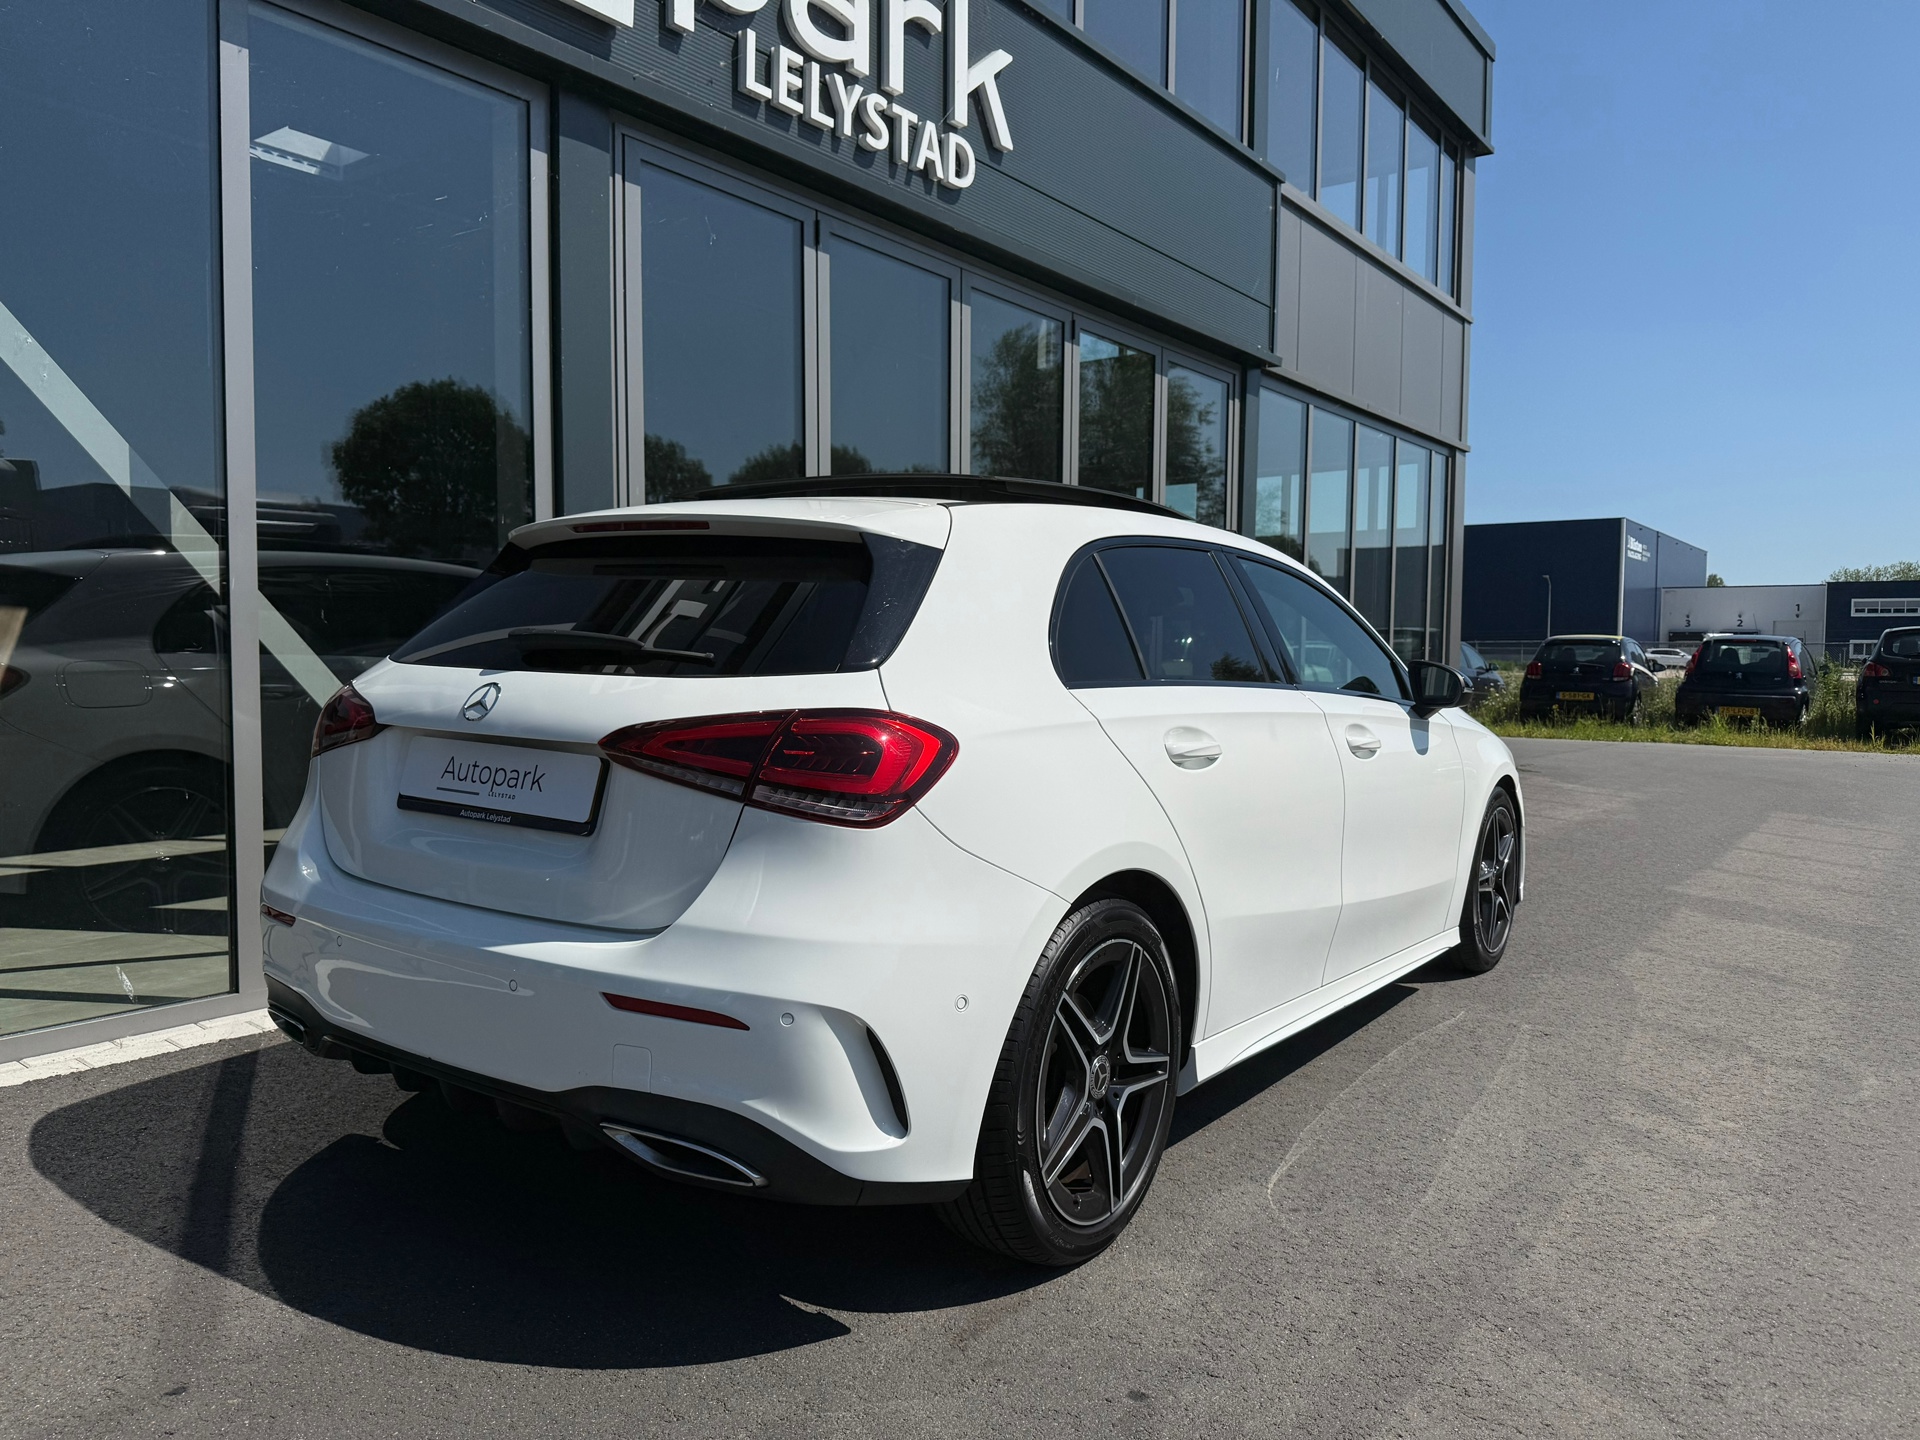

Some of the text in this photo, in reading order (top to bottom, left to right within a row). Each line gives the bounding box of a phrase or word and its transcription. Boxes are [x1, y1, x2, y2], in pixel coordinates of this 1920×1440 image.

[737, 28, 975, 190] LELYSTAD
[1795, 603, 1801, 612] 1
[1684, 619, 1691, 628] 3
[1736, 619, 1744, 628] 2
[441, 756, 546, 792] Autopark
[488, 792, 516, 800] LELYSTAD
[460, 809, 512, 823] Autopark Lelystad
